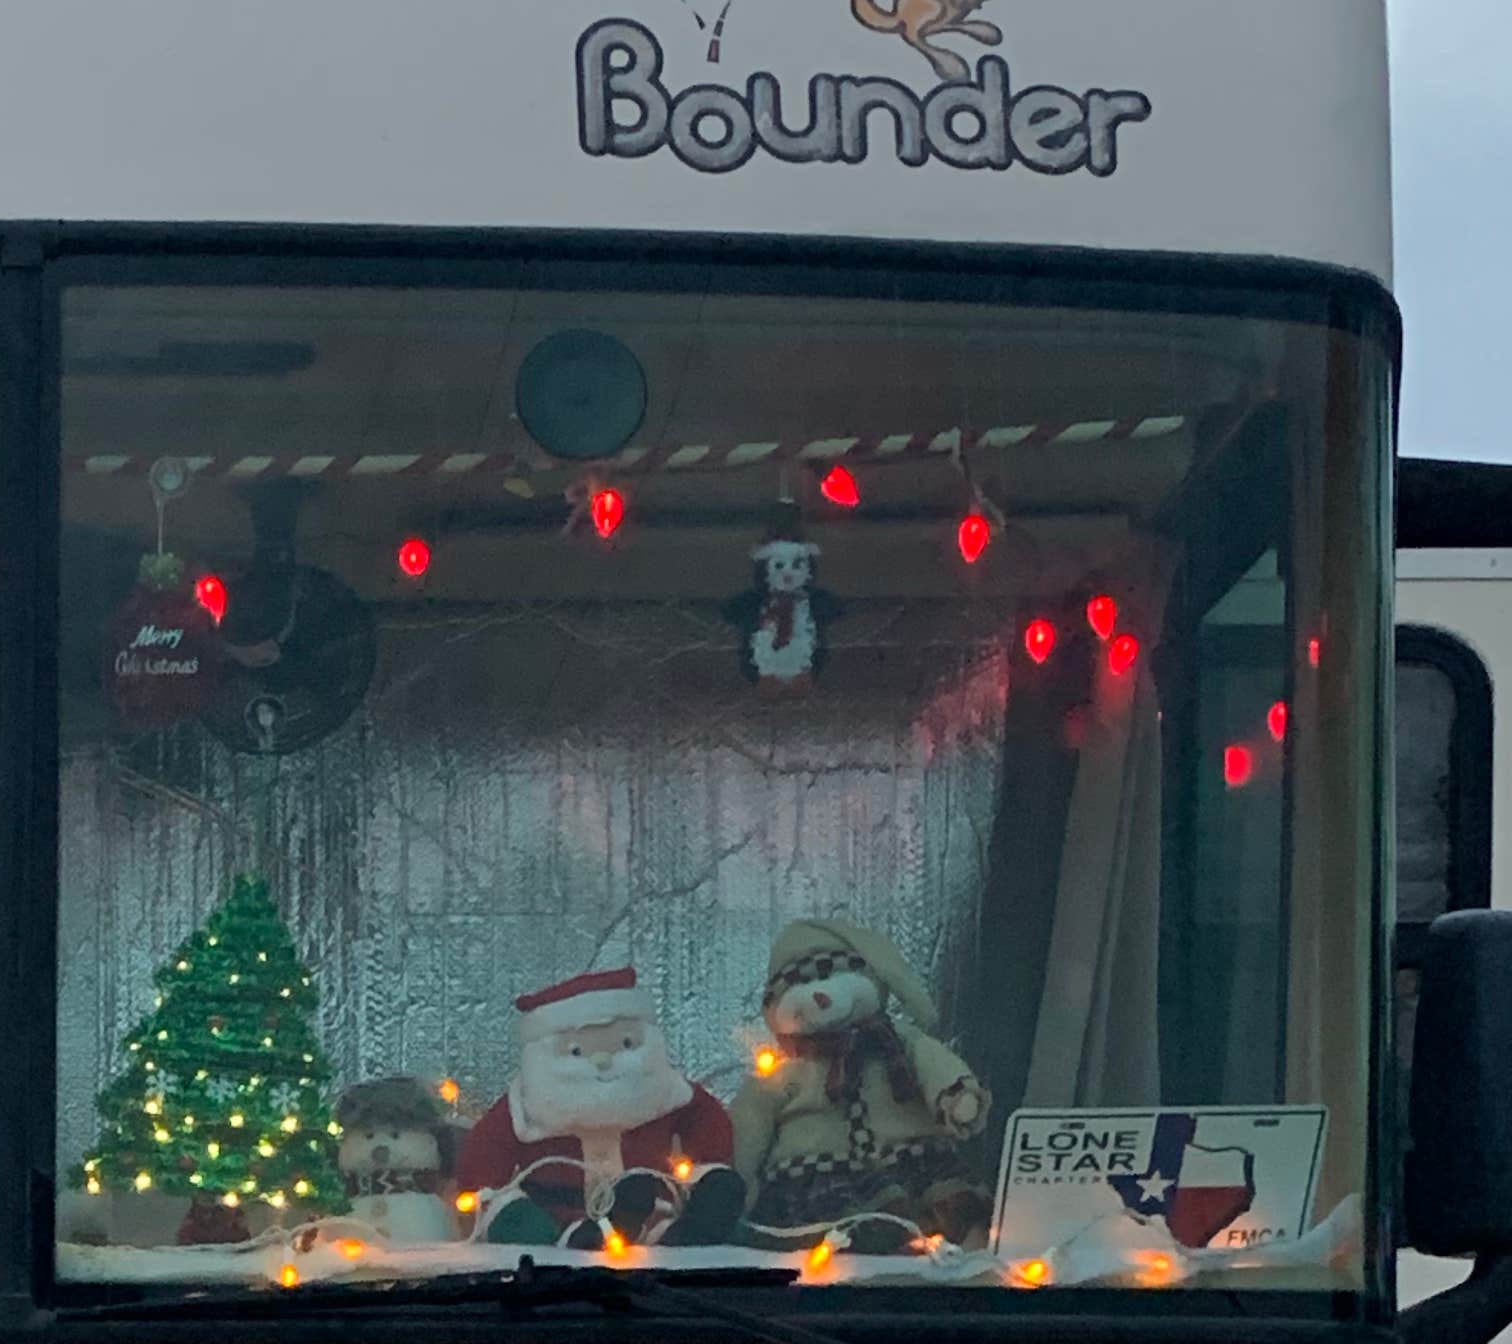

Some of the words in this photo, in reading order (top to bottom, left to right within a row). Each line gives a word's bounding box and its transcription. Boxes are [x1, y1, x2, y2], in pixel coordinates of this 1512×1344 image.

[576, 17, 1152, 178] Bounder
[129, 624, 185, 648] Merry
[1019, 1130, 1141, 1151] LONE
[1017, 1153, 1135, 1172] STAR
[1013, 1176, 1103, 1186] CHAPTER
